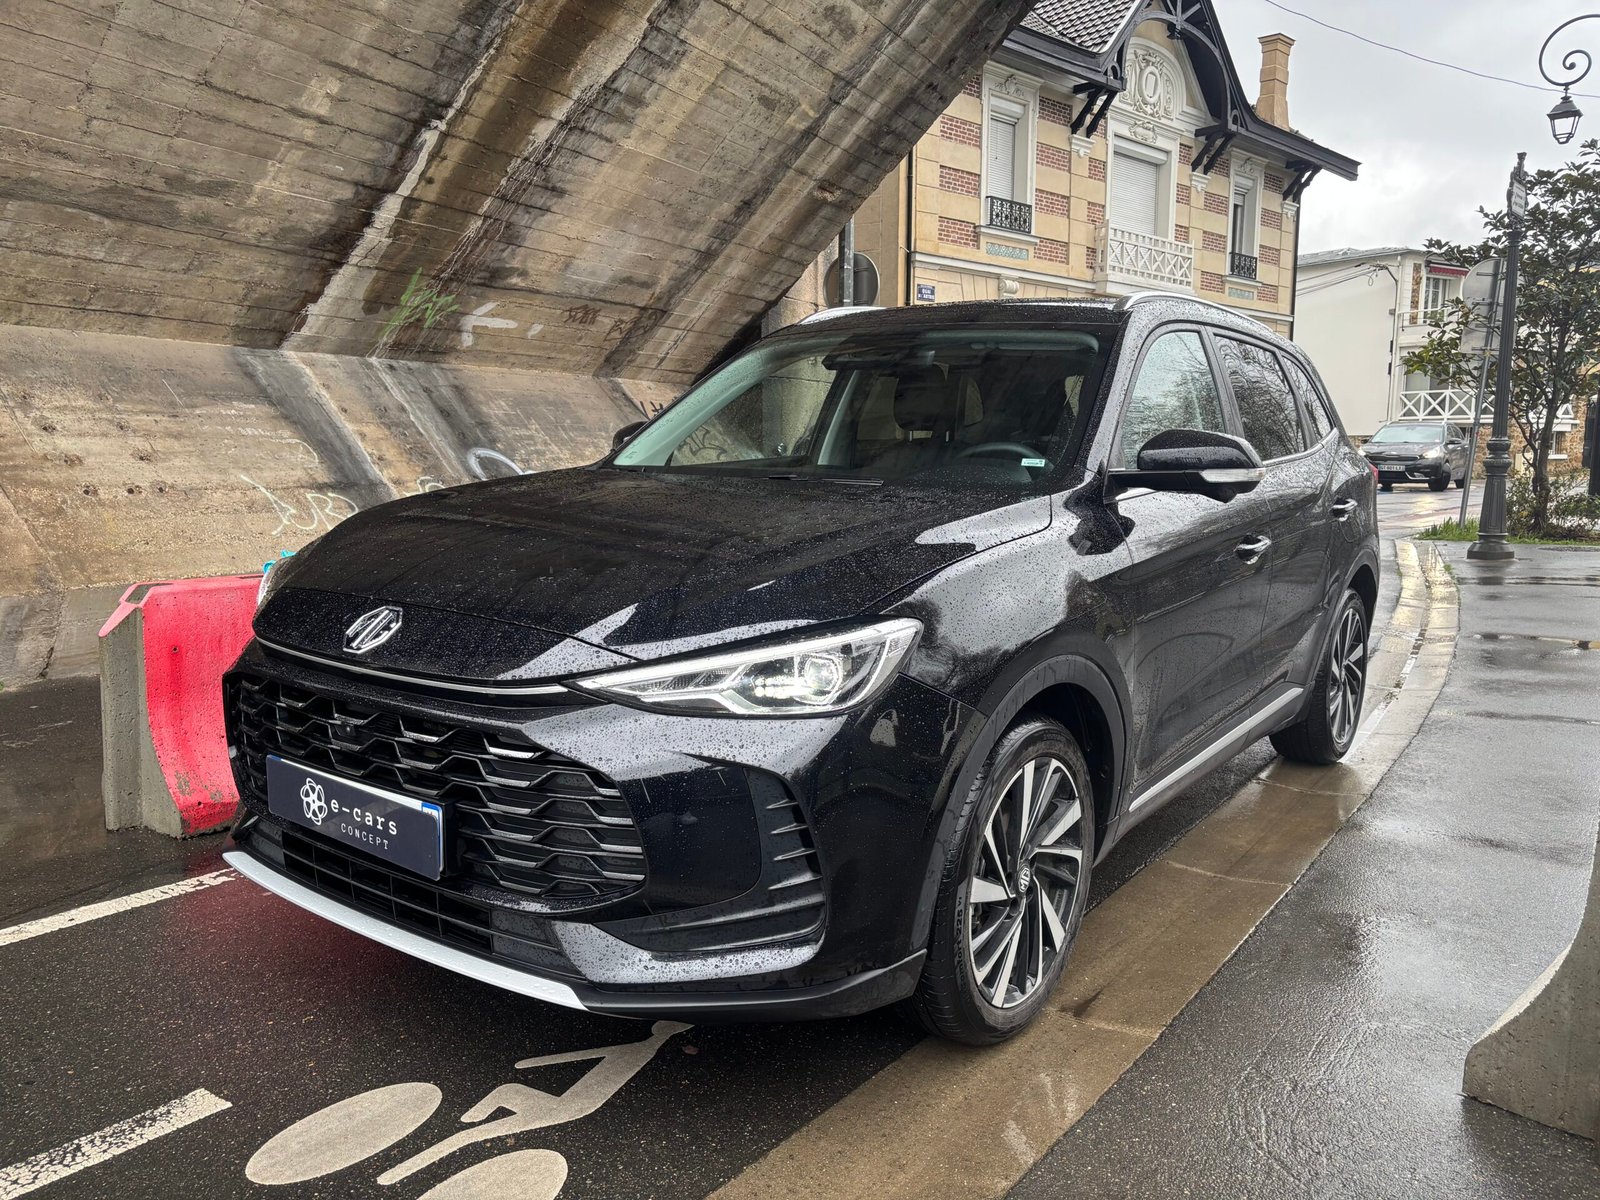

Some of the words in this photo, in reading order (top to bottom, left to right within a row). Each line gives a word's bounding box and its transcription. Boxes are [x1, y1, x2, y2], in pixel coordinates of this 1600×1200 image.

[347, 609, 398, 649] MG
[330, 799, 398, 835] e-cars
[340, 823, 389, 850] CONCEPT
